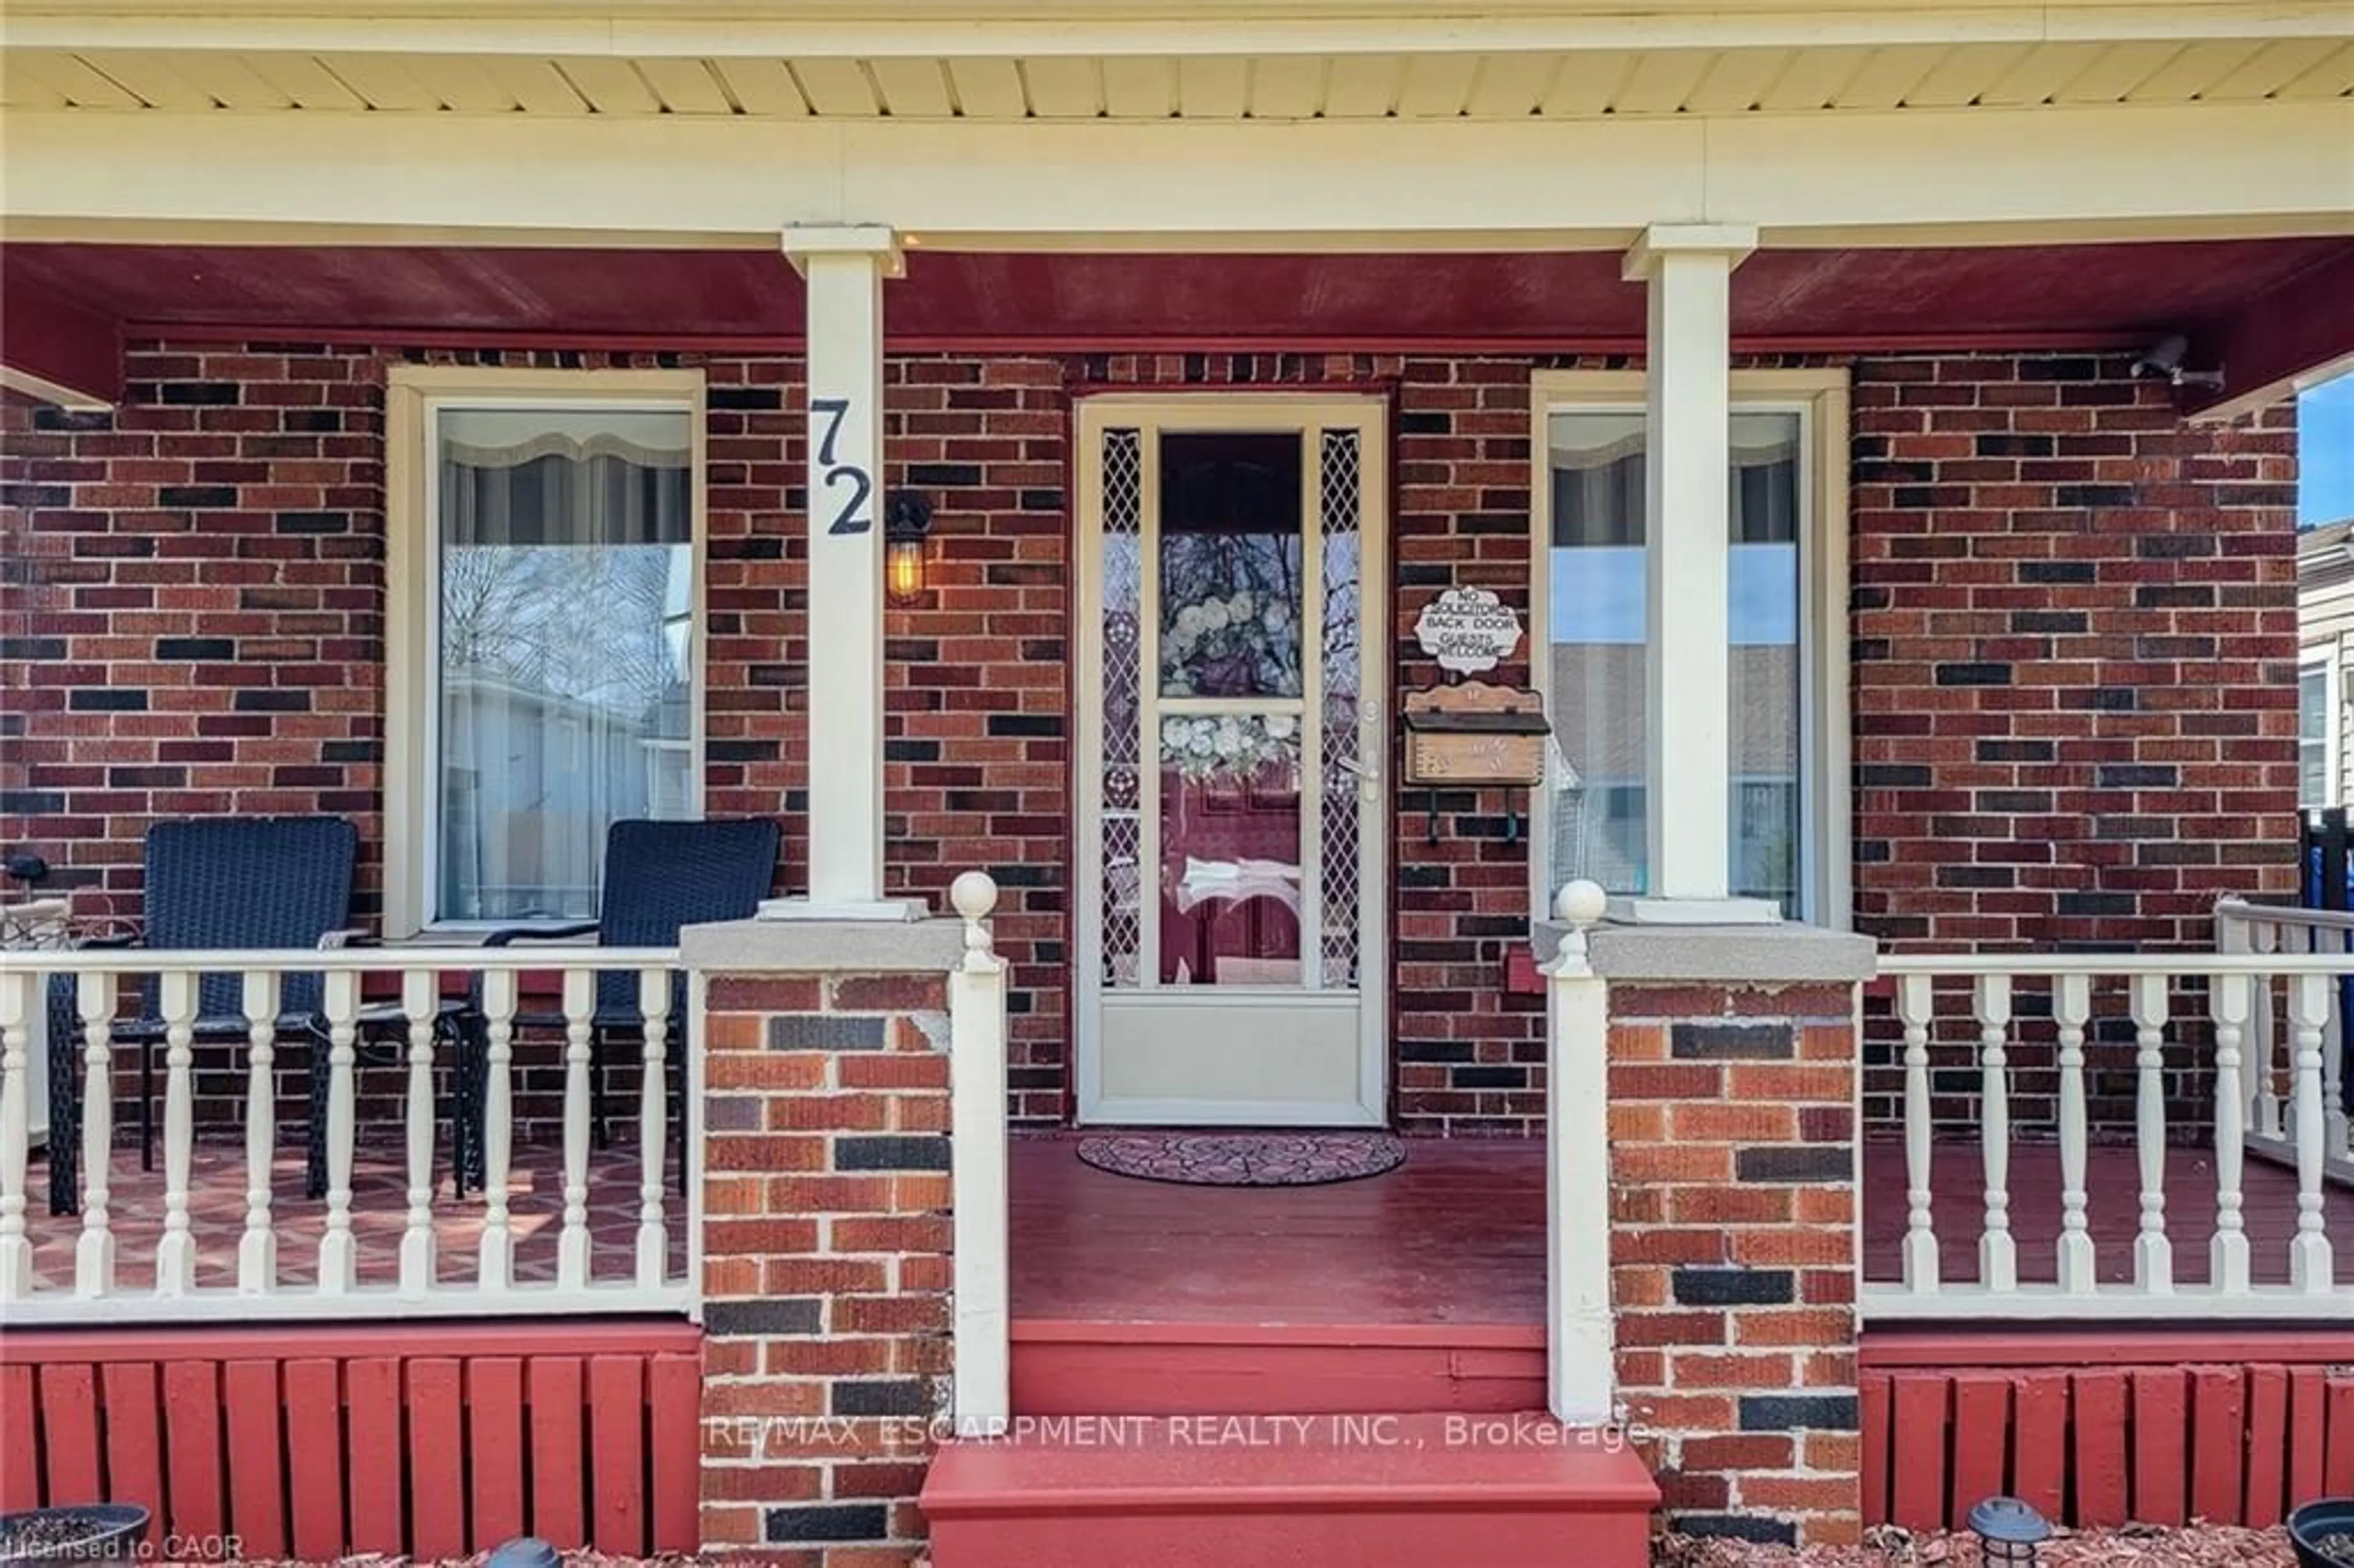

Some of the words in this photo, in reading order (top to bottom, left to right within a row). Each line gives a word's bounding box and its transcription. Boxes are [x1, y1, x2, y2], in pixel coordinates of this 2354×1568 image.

[810, 399, 871, 534] 72
[1458, 590, 1479, 602] NO
[1426, 615, 1466, 629] BACK
[1473, 617, 1514, 630] DOOR
[1439, 632, 1494, 645] GUESTS
[1437, 643, 1503, 658] WELCOME
